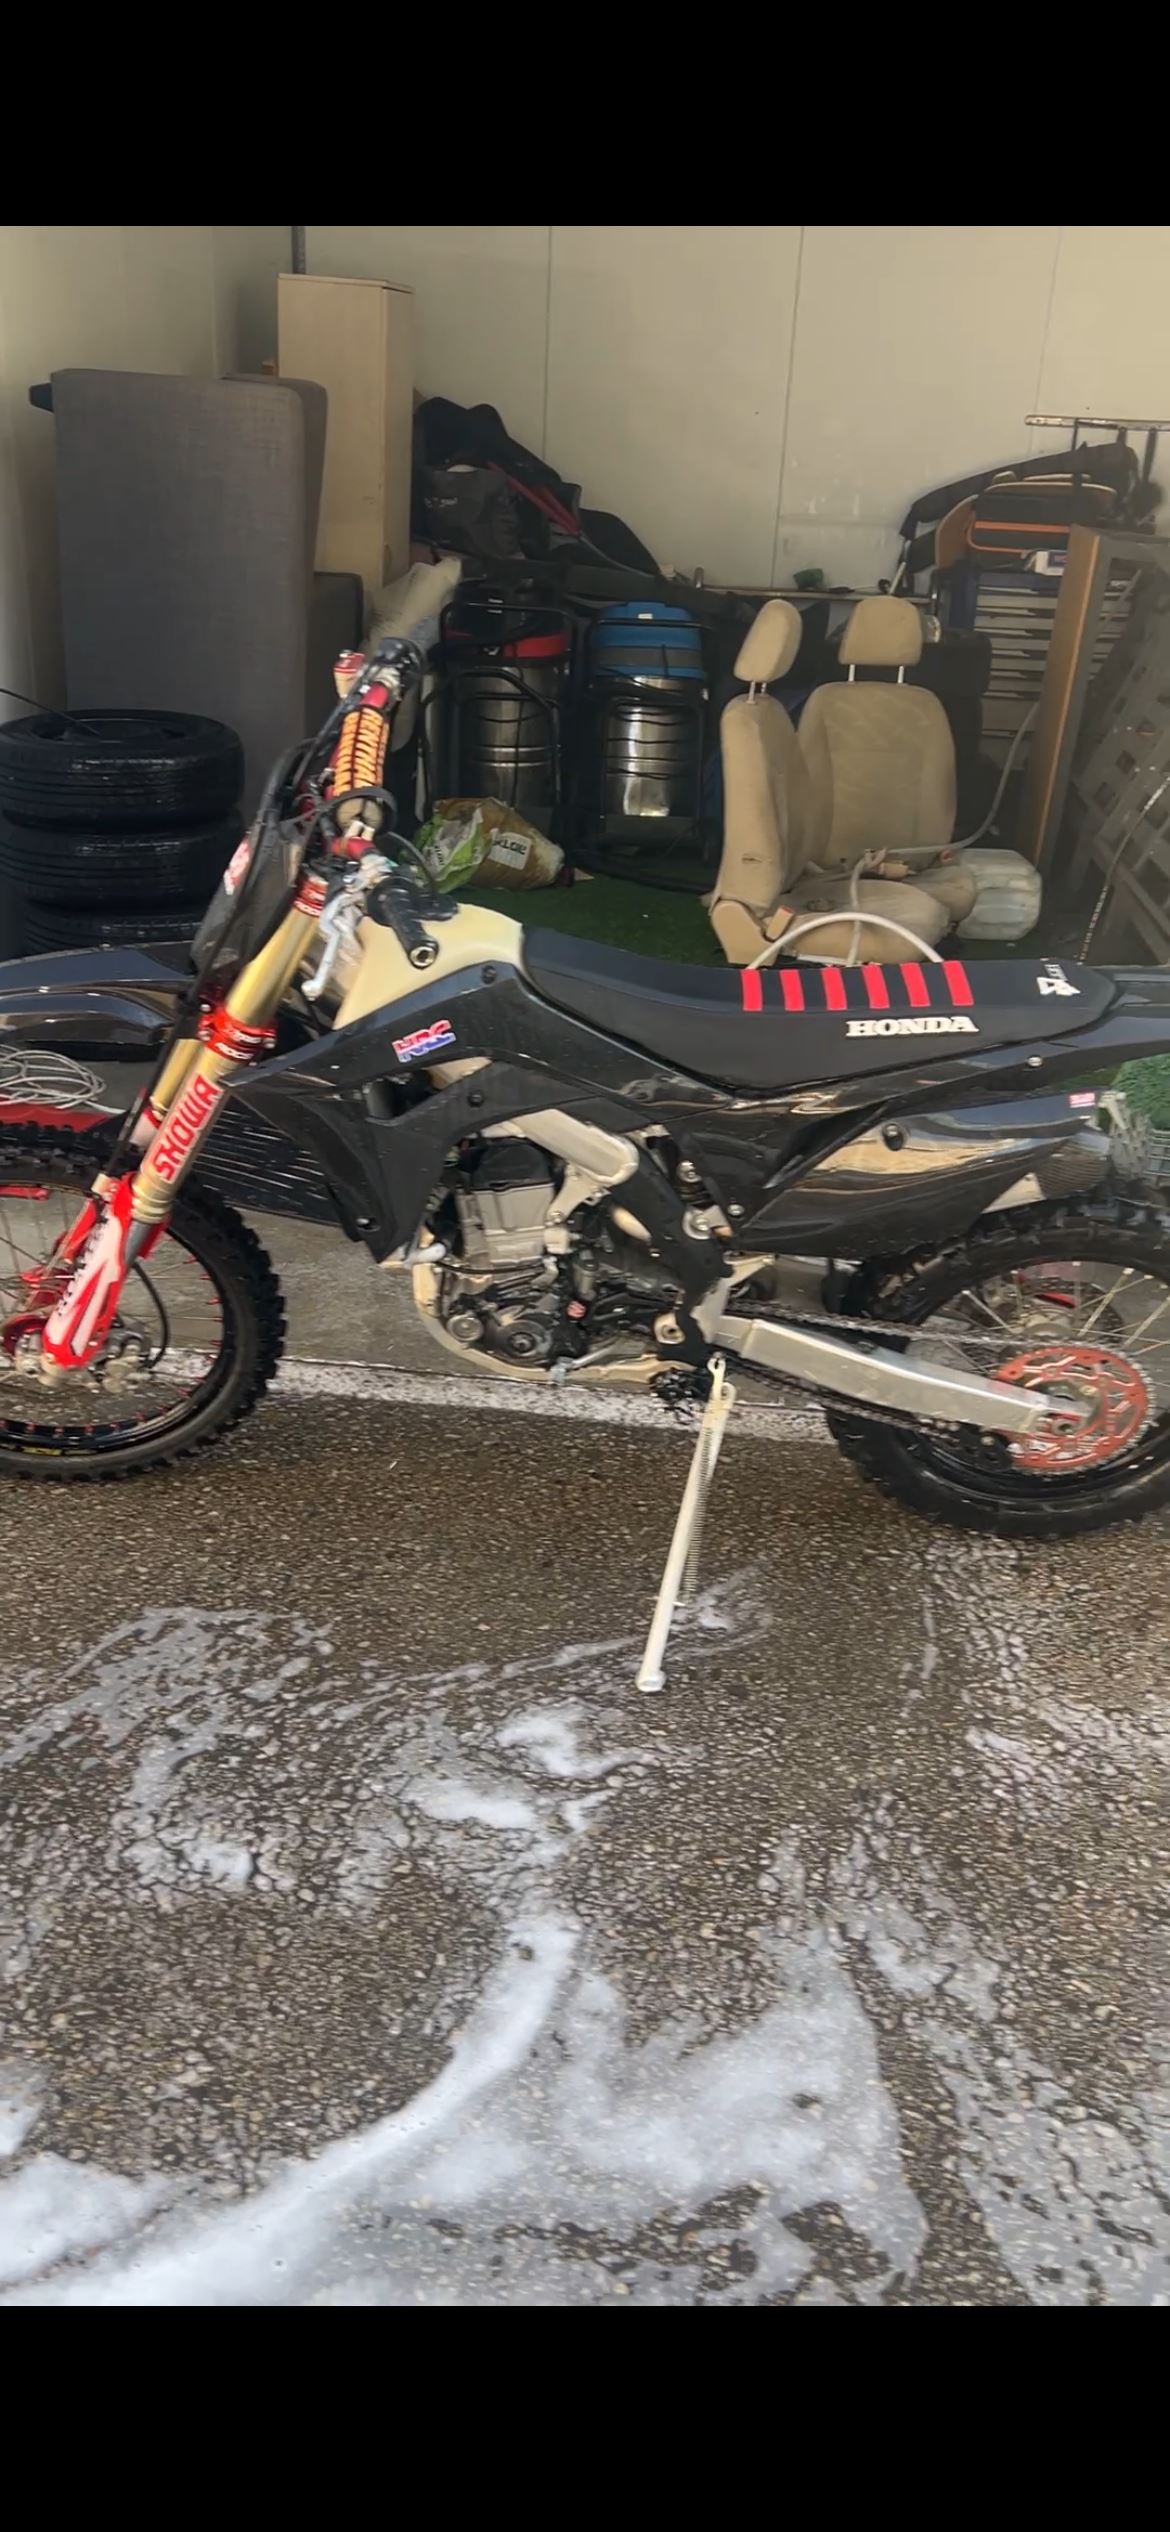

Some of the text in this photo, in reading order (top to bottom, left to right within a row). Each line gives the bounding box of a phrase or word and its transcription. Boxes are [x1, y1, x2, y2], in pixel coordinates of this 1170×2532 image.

[392, 1020, 456, 1063] HRC
[846, 1016, 980, 1037] HONDA
[152, 1073, 220, 1182] SHOWA
